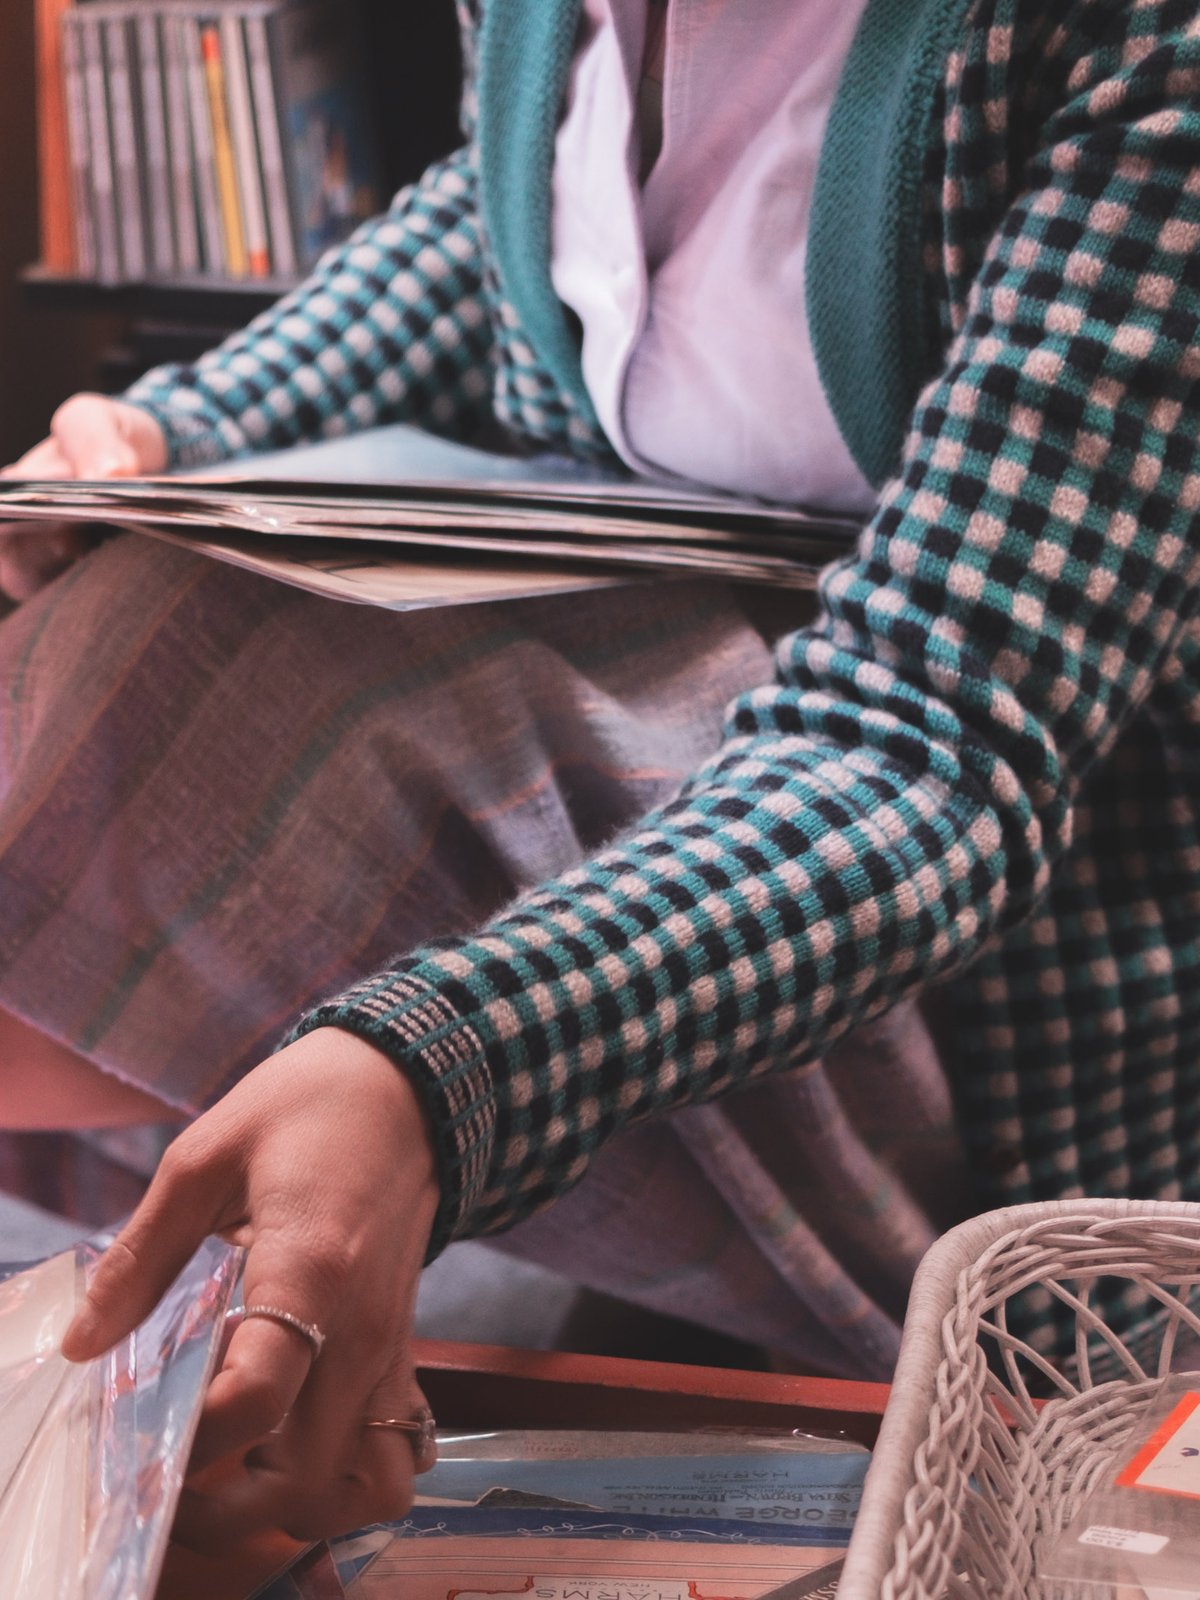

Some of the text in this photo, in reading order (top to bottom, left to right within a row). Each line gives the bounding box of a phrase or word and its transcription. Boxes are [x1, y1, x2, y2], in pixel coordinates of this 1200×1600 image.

[693, 1471, 789, 1480] HARMS
[735, 1505, 859, 1523] EORGE
[535, 1588, 681, 1600] HARMS
